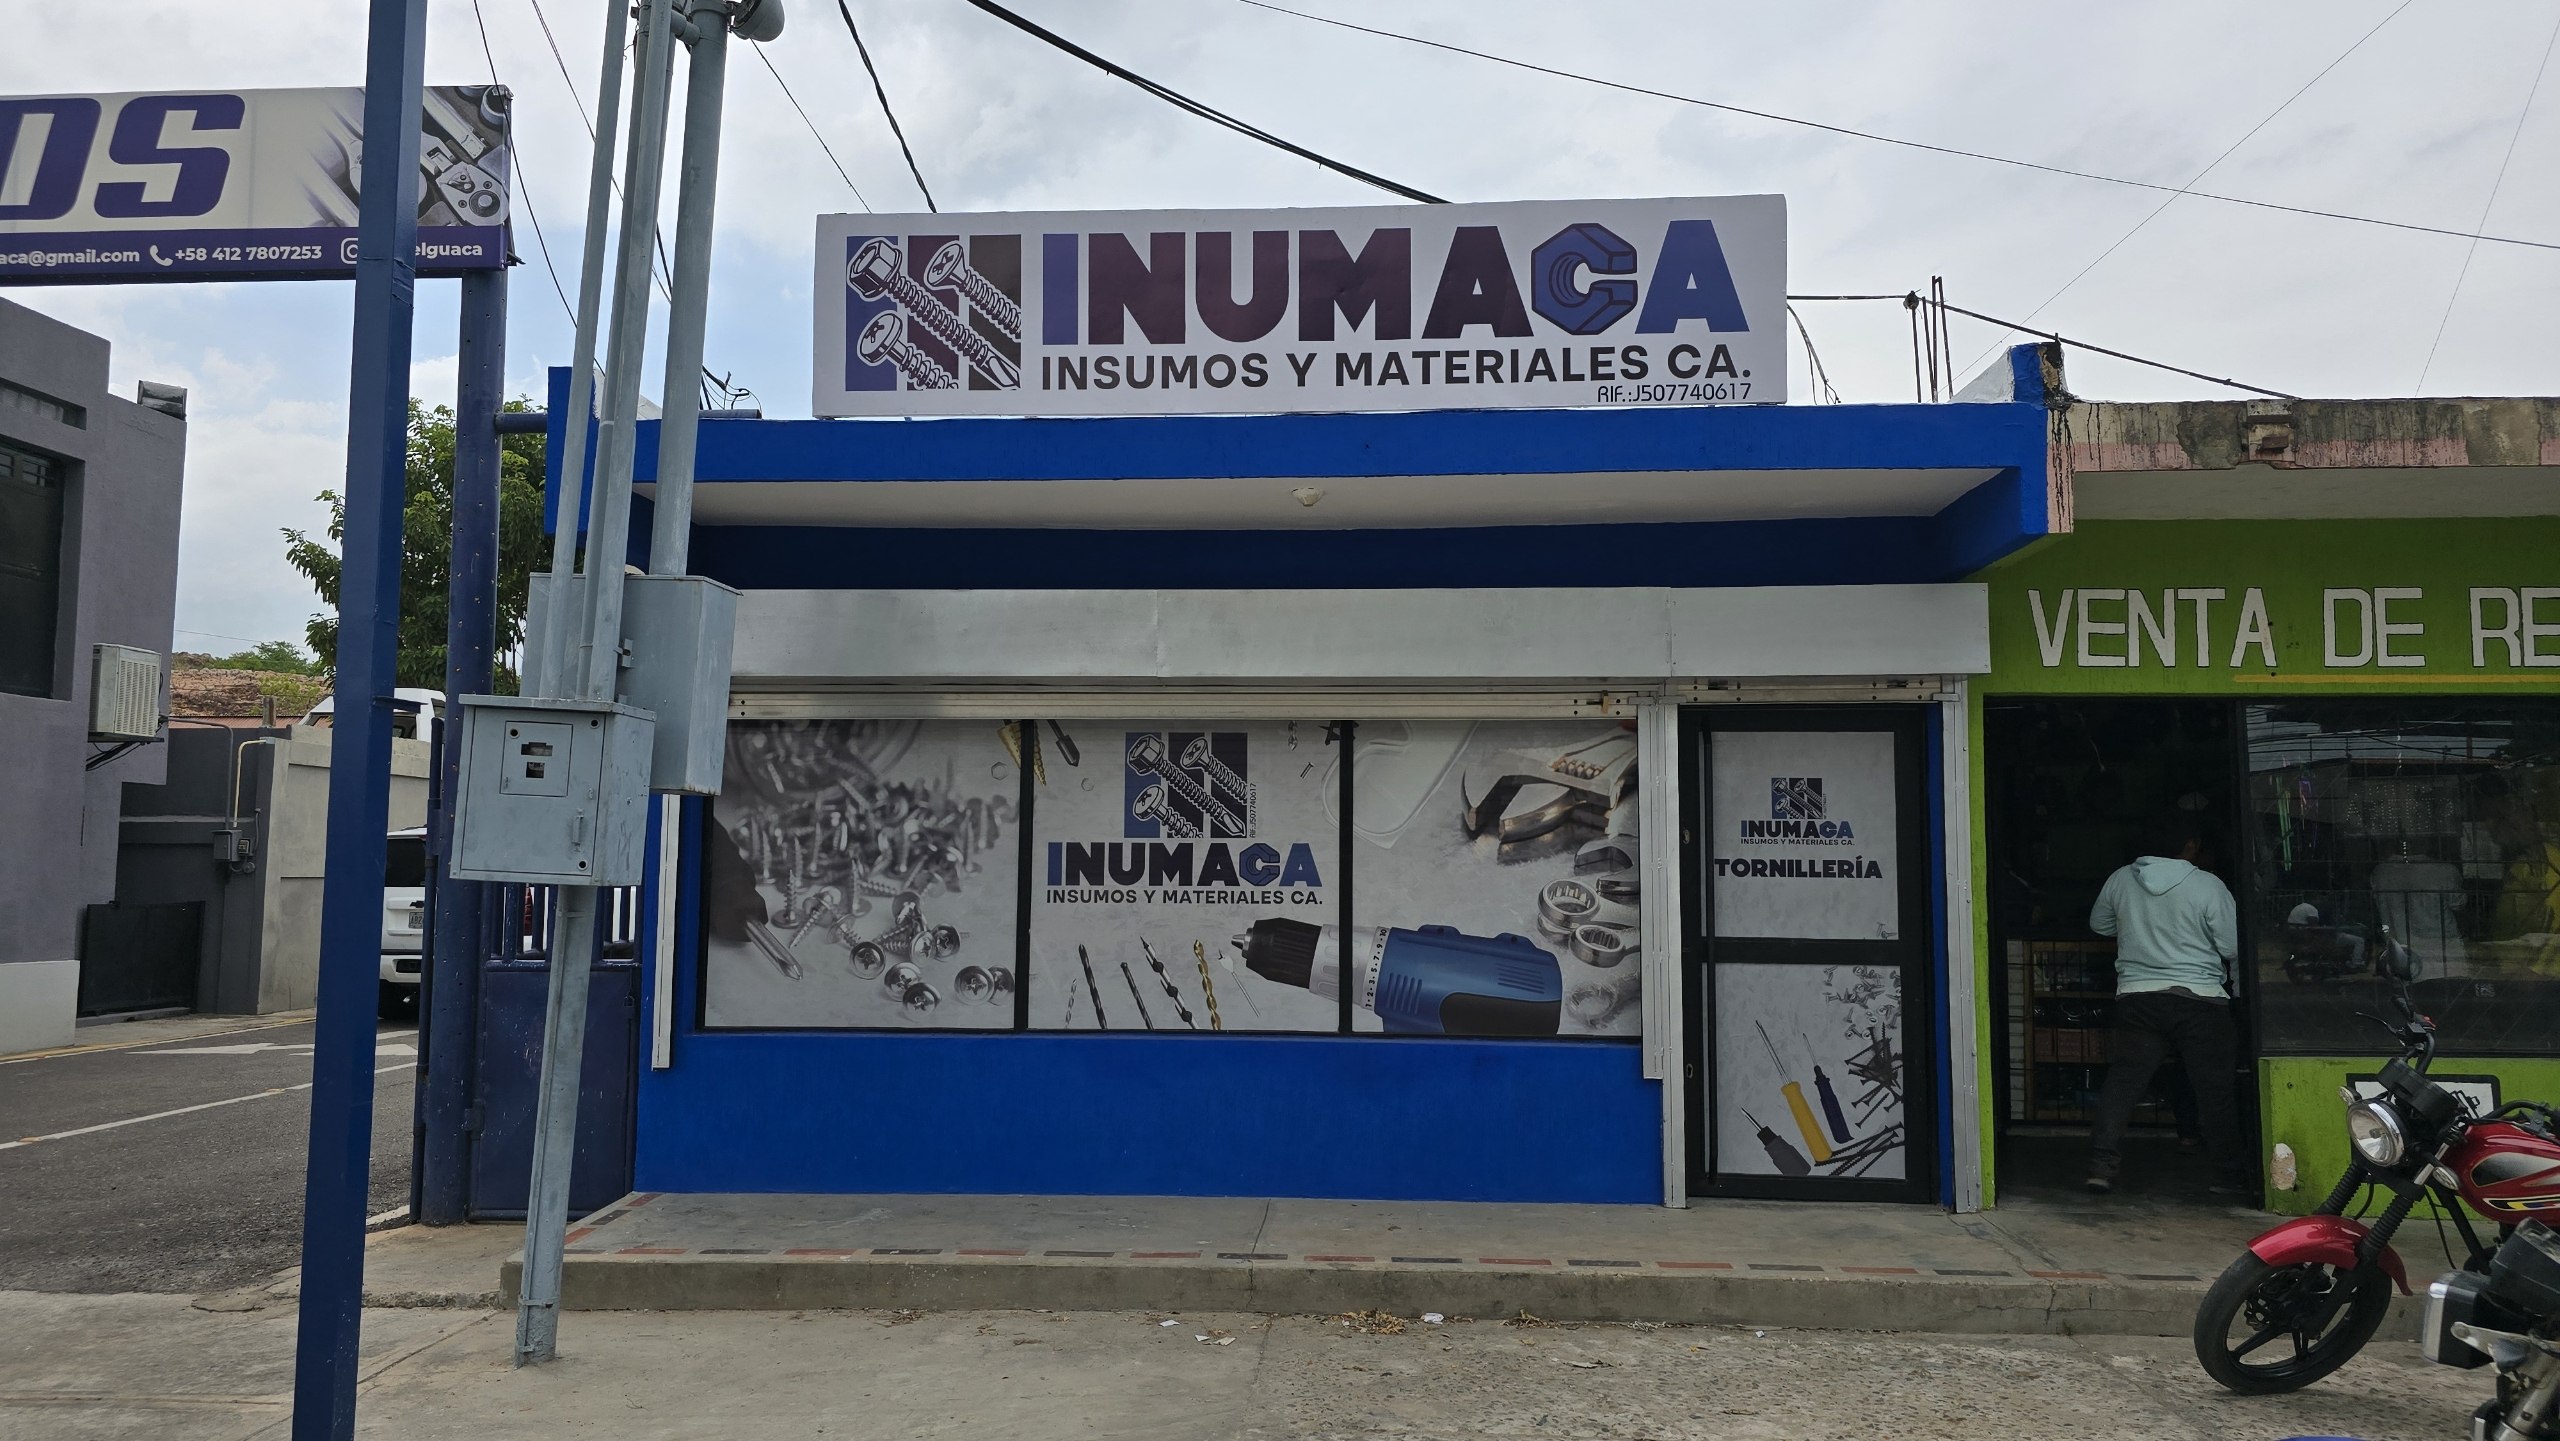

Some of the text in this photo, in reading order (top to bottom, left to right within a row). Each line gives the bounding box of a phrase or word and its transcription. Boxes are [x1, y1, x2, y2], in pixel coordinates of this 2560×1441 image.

[175, 247, 208, 261] +58
[212, 247, 242, 261] 412
[245, 245, 322, 261] 7807253
[1042, 219, 1751, 346] INUMACA
[1042, 343, 1752, 391] INSUMOS Y MATERIALES CA.
[2027, 586, 2560, 668] VENTA DE RE
[1741, 820, 1855, 839] INUMACA
[1788, 838, 1839, 846] MATERIALES
[1047, 841, 1323, 887] INUMACA
[1714, 854, 1883, 879] TORNILLERÍA
[1046, 889, 1323, 905] INSUMOS Y MATERIALES CA.
